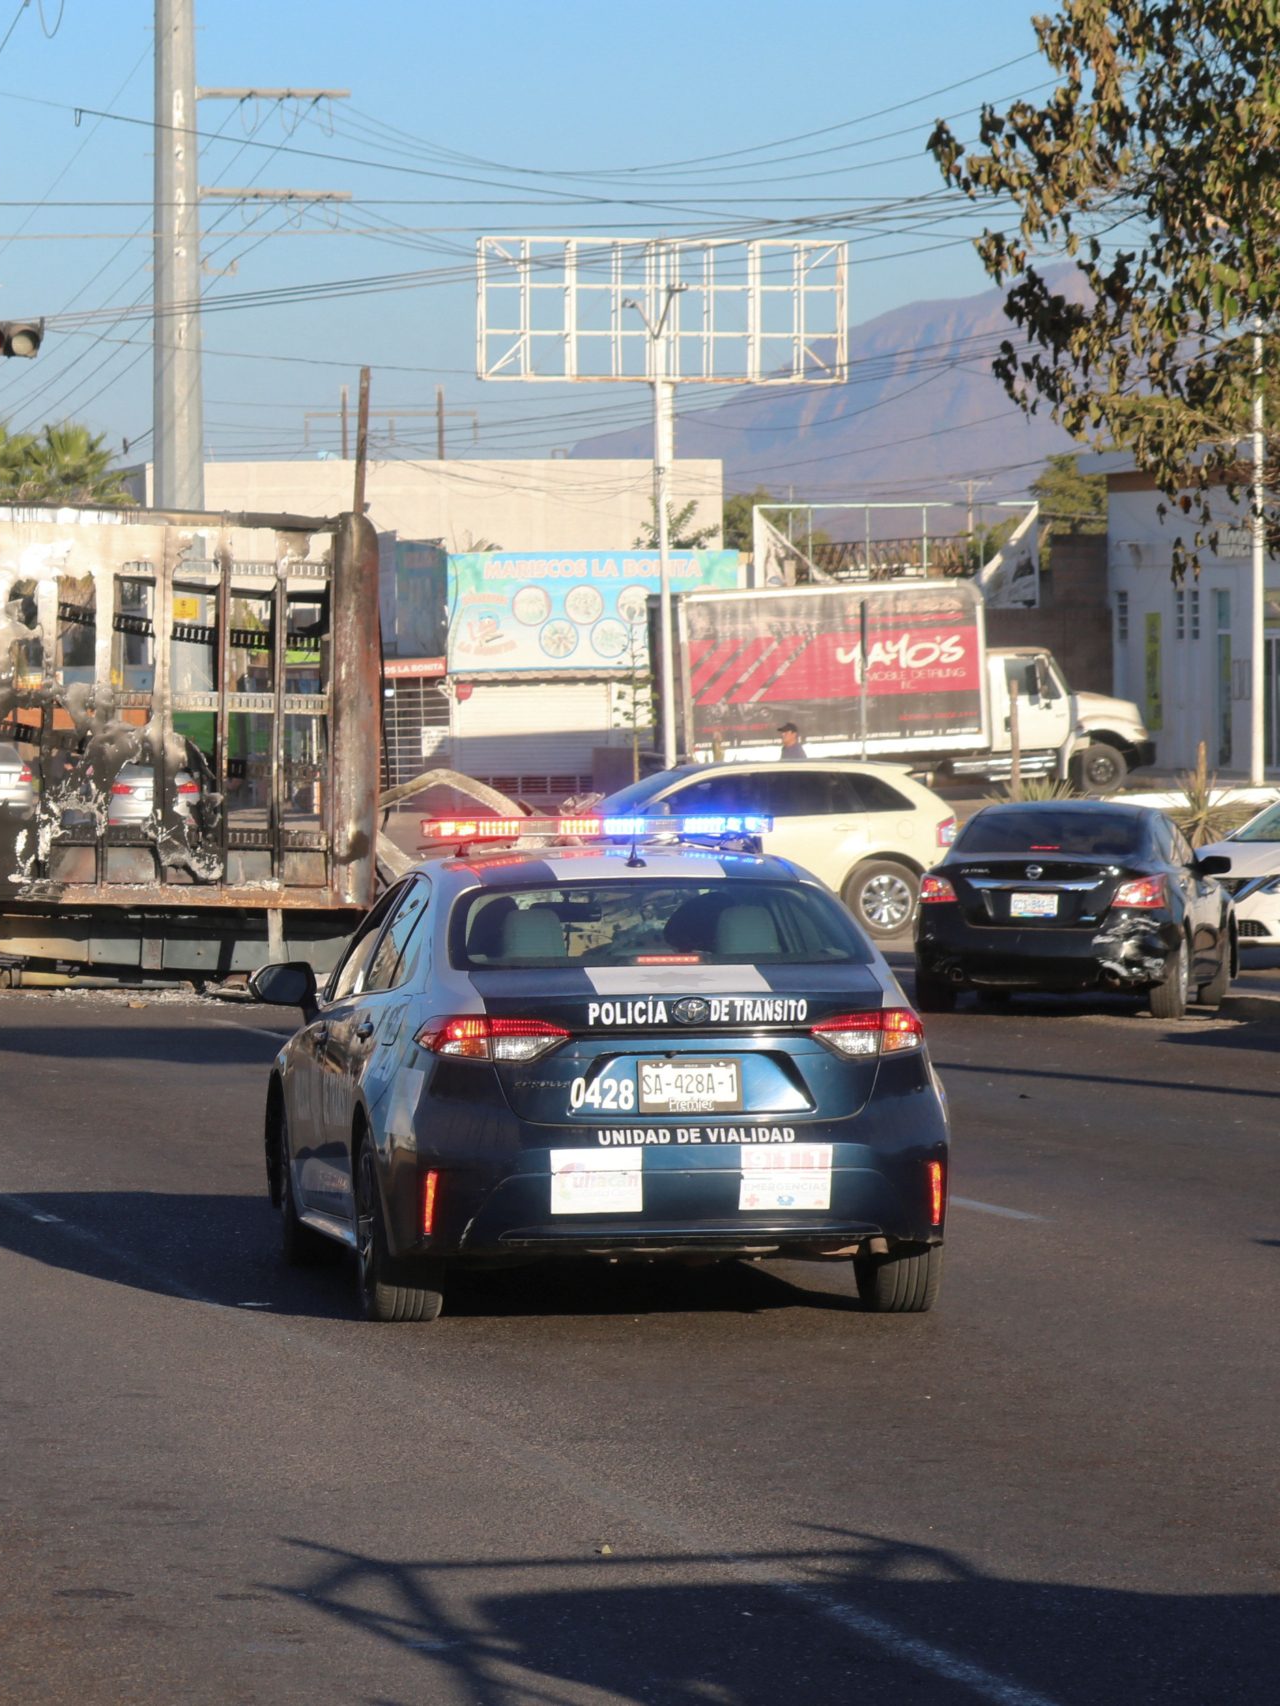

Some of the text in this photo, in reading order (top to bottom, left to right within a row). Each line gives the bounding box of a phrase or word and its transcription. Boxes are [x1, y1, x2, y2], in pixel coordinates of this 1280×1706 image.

[483, 560, 587, 580] MARISCOS
[591, 559, 619, 577] LA
[398, 664, 410, 672] LA
[411, 662, 444, 672] BONITA
[588, 996, 808, 1026] POLICÍA DE TRANSITO
[570, 1076, 635, 1110] 0428
[642, 1073, 735, 1095] SA-428A-1
[668, 1097, 715, 1111] Premier
[598, 1127, 796, 1145] UNIDAD DE VIALIDAD
[743, 1182, 828, 1192] EMERGENCIAS
